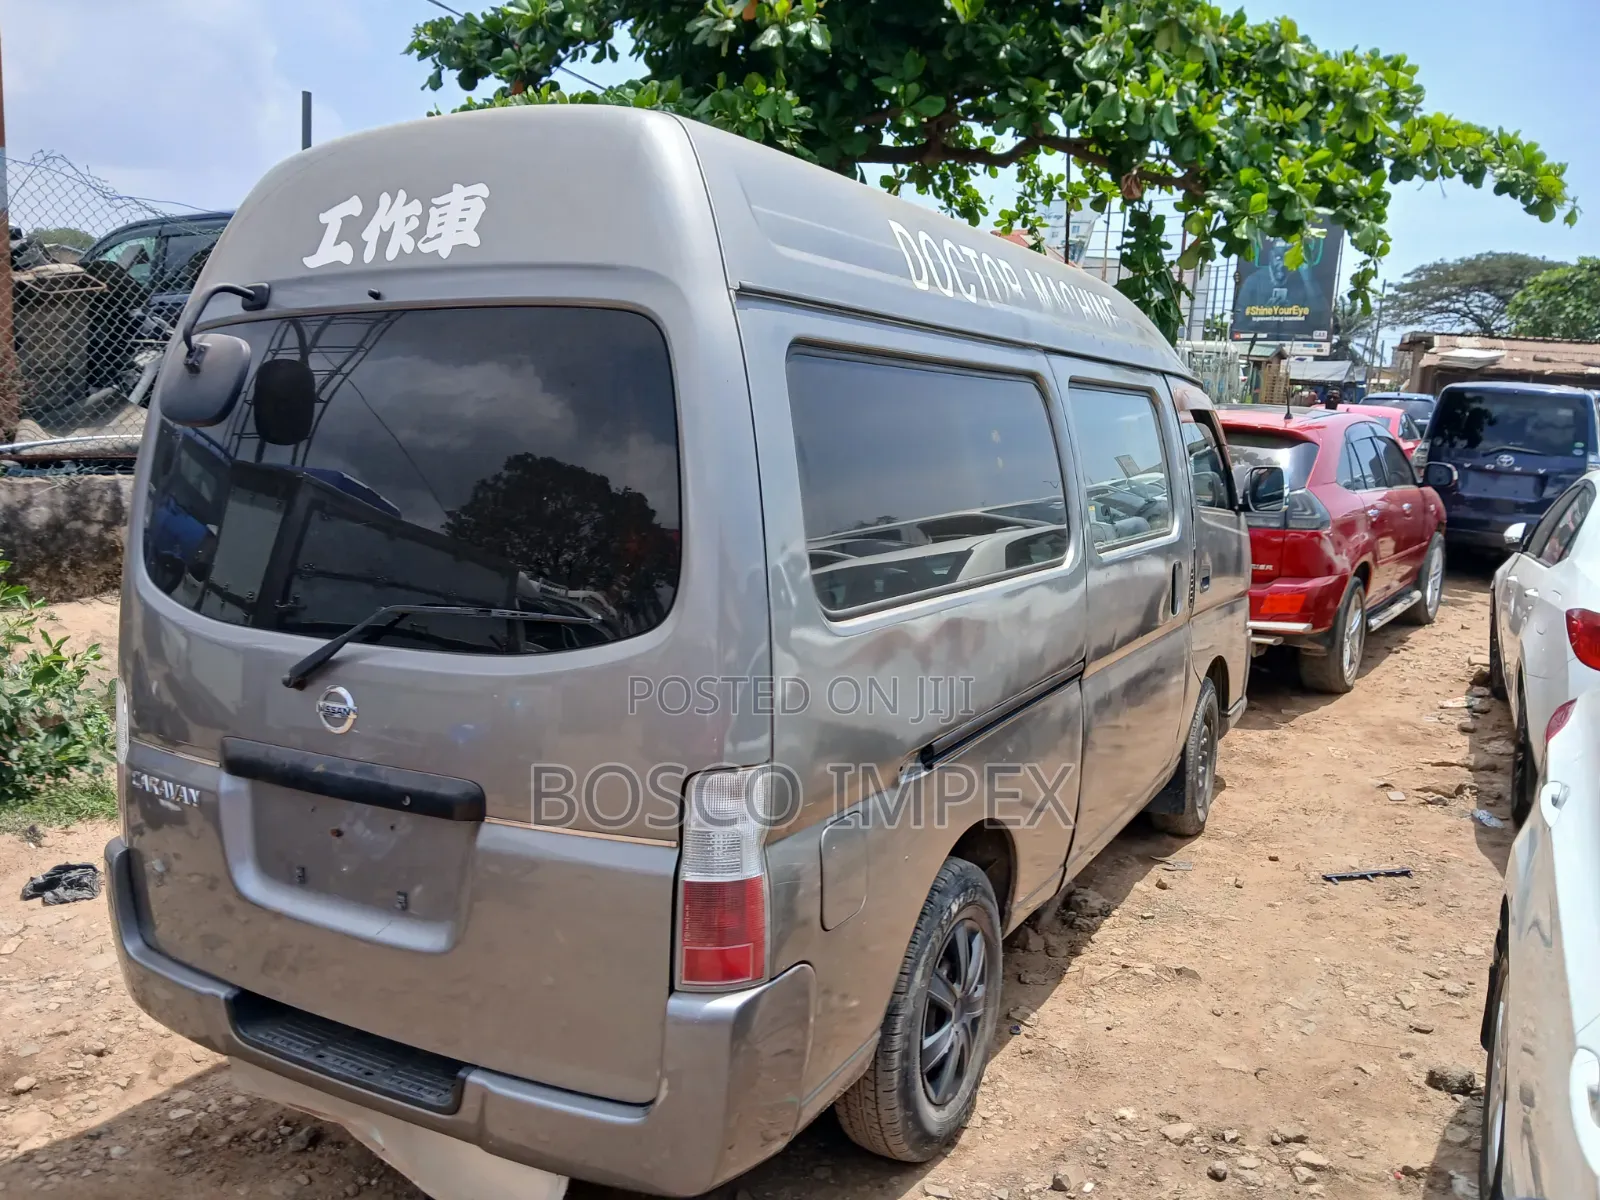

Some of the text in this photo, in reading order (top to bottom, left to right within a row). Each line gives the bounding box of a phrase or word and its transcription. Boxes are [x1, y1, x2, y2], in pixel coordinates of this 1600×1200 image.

[302, 182, 490, 269] 工作車
[888, 219, 1120, 328] DOCTOR MACHINE
[1245, 305, 1310, 317] #ShineYourEye
[317, 702, 352, 717] NISSAN
[132, 770, 200, 807] CARAVAN
